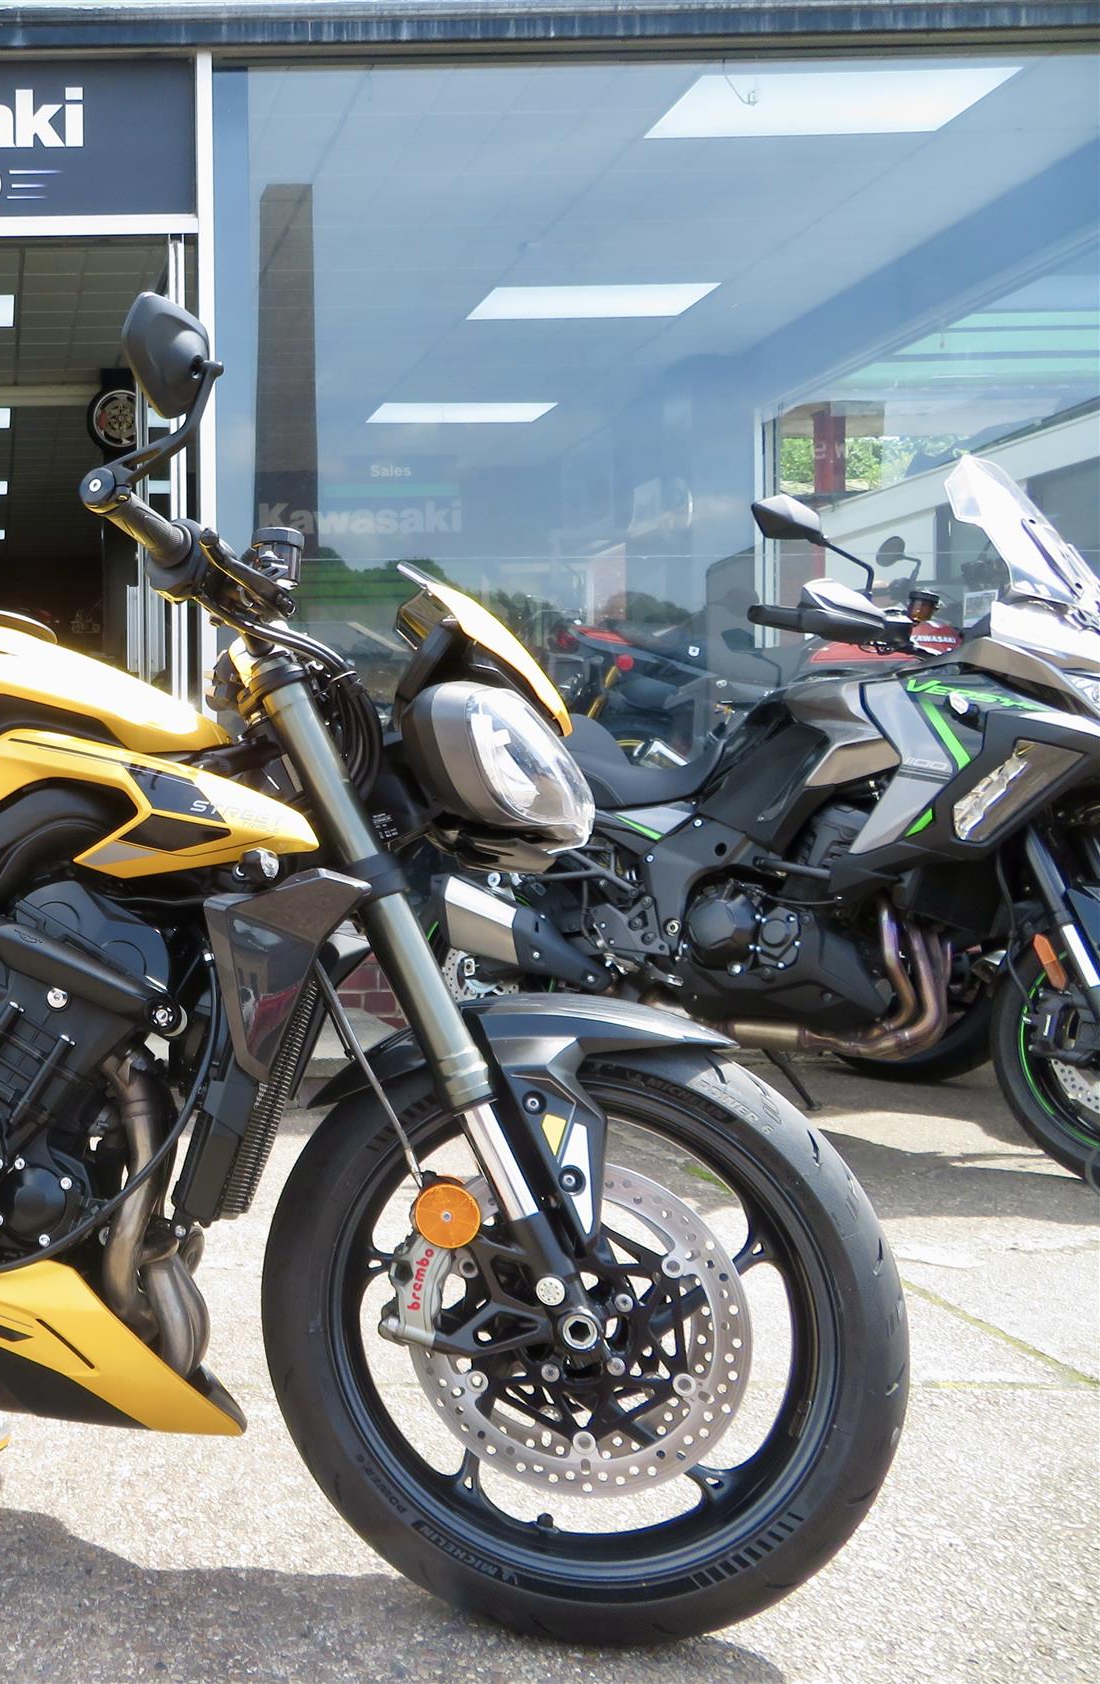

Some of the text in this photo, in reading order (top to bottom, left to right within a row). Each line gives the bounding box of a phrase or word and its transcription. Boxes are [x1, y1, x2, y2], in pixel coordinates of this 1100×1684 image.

[370, 464, 412, 478] Sales
[259, 501, 463, 535] Kawasaki
[189, 799, 284, 826] STREET
[645, 1076, 729, 1121] MICHELIN
[694, 1079, 775, 1136] POWER 6
[407, 1248, 434, 1311] brembo
[364, 1466, 408, 1515] POWER
[419, 1524, 499, 1576] MICHELIN
